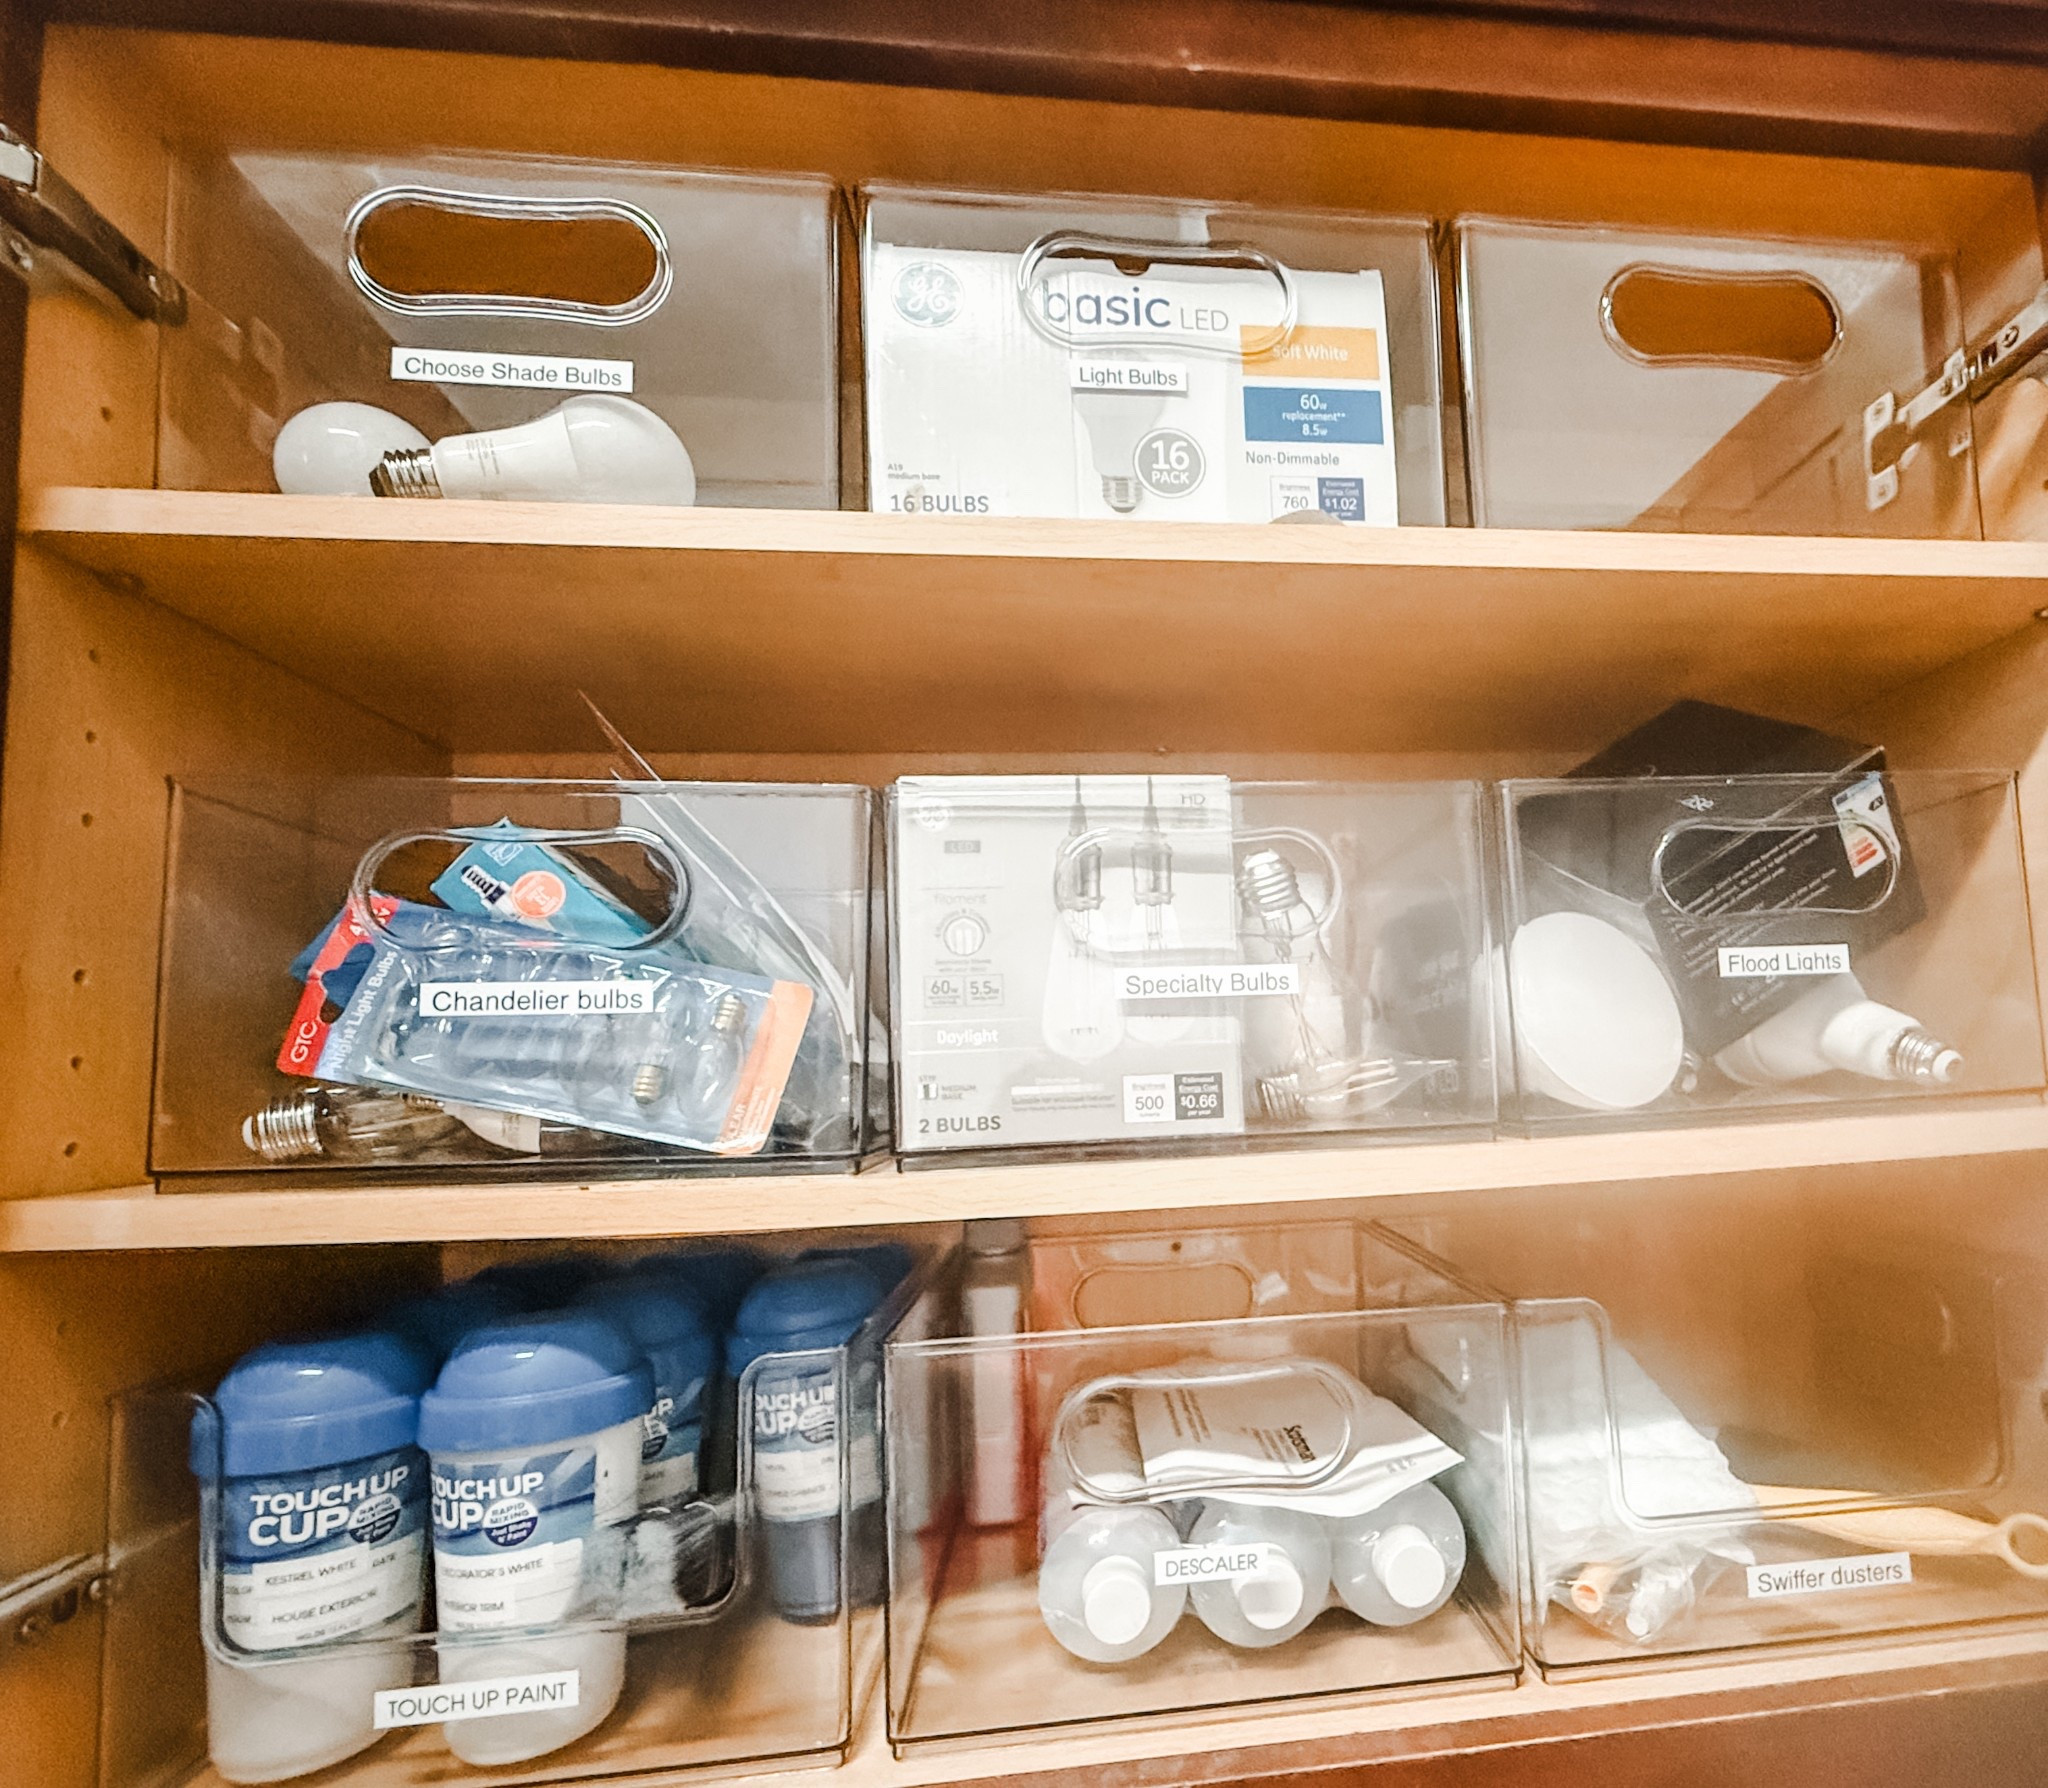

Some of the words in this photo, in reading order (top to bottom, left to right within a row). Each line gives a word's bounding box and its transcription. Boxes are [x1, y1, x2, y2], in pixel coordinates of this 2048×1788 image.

[1043, 279, 1171, 329] basic
[1180, 307, 1229, 332] LED
[1304, 346, 1349, 362] White
[404, 356, 484, 378] Choose
[492, 362, 558, 382] Shade
[565, 367, 622, 386] Bulbs
[1079, 366, 1123, 387] Light
[1129, 369, 1178, 387] Bulbs
[1151, 440, 1190, 471] 16
[1246, 451, 1340, 466] Non-Dimmable
[1151, 471, 1190, 486] PACK
[890, 494, 915, 513] 16
[921, 494, 989, 514] BULBS
[1282, 496, 1309, 509] 760
[367, 950, 399, 989] Bulbs
[1728, 953, 1780, 973] Flood
[1785, 952, 1842, 971] Lights
[1125, 973, 1223, 996] Specialty
[1230, 972, 1290, 992] Bulbs
[432, 990, 569, 1012] Chandelier
[578, 988, 643, 1010] bulbs
[290, 1021, 318, 1063] GTC
[936, 1028, 1000, 1047] Daylight
[1134, 1095, 1164, 1111] 500
[1180, 1093, 1218, 1110] $0.66
[919, 1118, 930, 1134] 2
[936, 1115, 1002, 1133] BULBS
[250, 1477, 368, 1516] TOUCH
[369, 1465, 409, 1495] UP
[500, 1471, 545, 1498] UP
[489, 1509, 530, 1525] MIXING
[491, 1502, 525, 1516] RAPID
[249, 1505, 350, 1547] CUP
[265, 1570, 315, 1586] KESTREL
[318, 1558, 358, 1577] WHITE
[508, 1558, 544, 1576] WHITE
[1165, 1553, 1258, 1578] DESCALER
[1757, 1568, 1825, 1594] Swiffer
[1831, 1564, 1904, 1586] dusters
[271, 1607, 316, 1625] HOUSE
[318, 1589, 379, 1615] EXTERIOR
[388, 1693, 466, 1719] TOUCH
[472, 1688, 500, 1711] UP
[506, 1681, 568, 1707] PAINT
